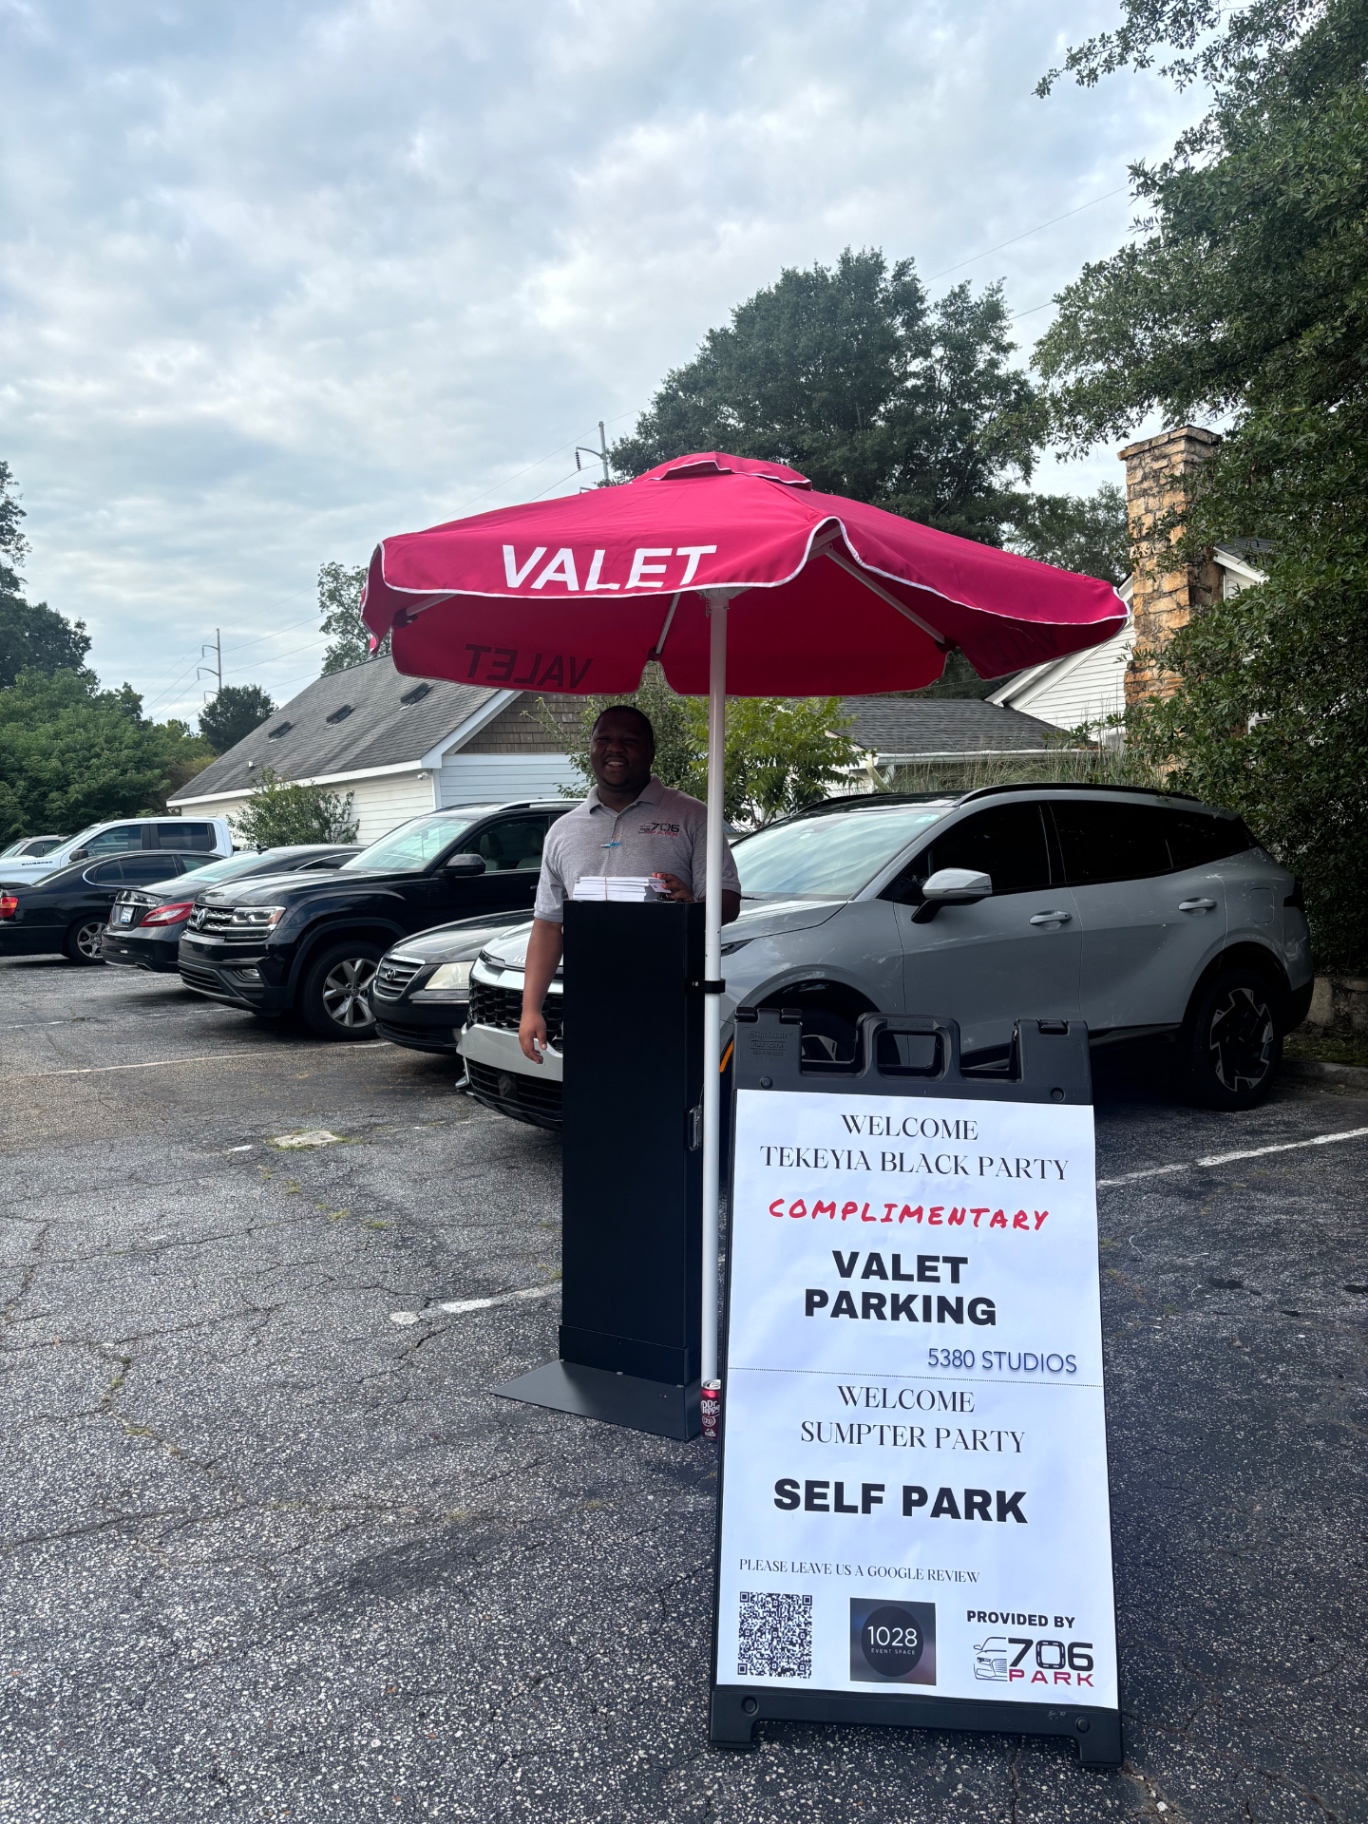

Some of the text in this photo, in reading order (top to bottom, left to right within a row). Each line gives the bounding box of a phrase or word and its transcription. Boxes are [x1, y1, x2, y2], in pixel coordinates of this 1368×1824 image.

[502, 544, 717, 591] VALET
[651, 822, 681, 833] 706
[841, 1114, 979, 1141] WELCOME
[760, 1146, 1069, 1181] TEKEYIA BLACK PARTY
[769, 1198, 1050, 1231] COMPLIMENTARY
[832, 1250, 969, 1284] VALET
[804, 1288, 997, 1326] PARKING
[928, 1348, 1078, 1375] 5380 STUDIOS
[701, 1400, 720, 1416] Peppe
[837, 1385, 976, 1413] WELCOME
[800, 1420, 1026, 1453] SUMPTER PARTY
[773, 1477, 1029, 1524] SELF PARK
[739, 1558, 981, 1583] PLEASE LEAVE US A GOOGLE REVIEW
[966, 1610, 1076, 1629] PROVIDED BY
[867, 1625, 918, 1647] 1028
[870, 1647, 892, 1655] EVENT
[1008, 1637, 1094, 1672] 706
[1008, 1668, 1095, 1688] PARK
